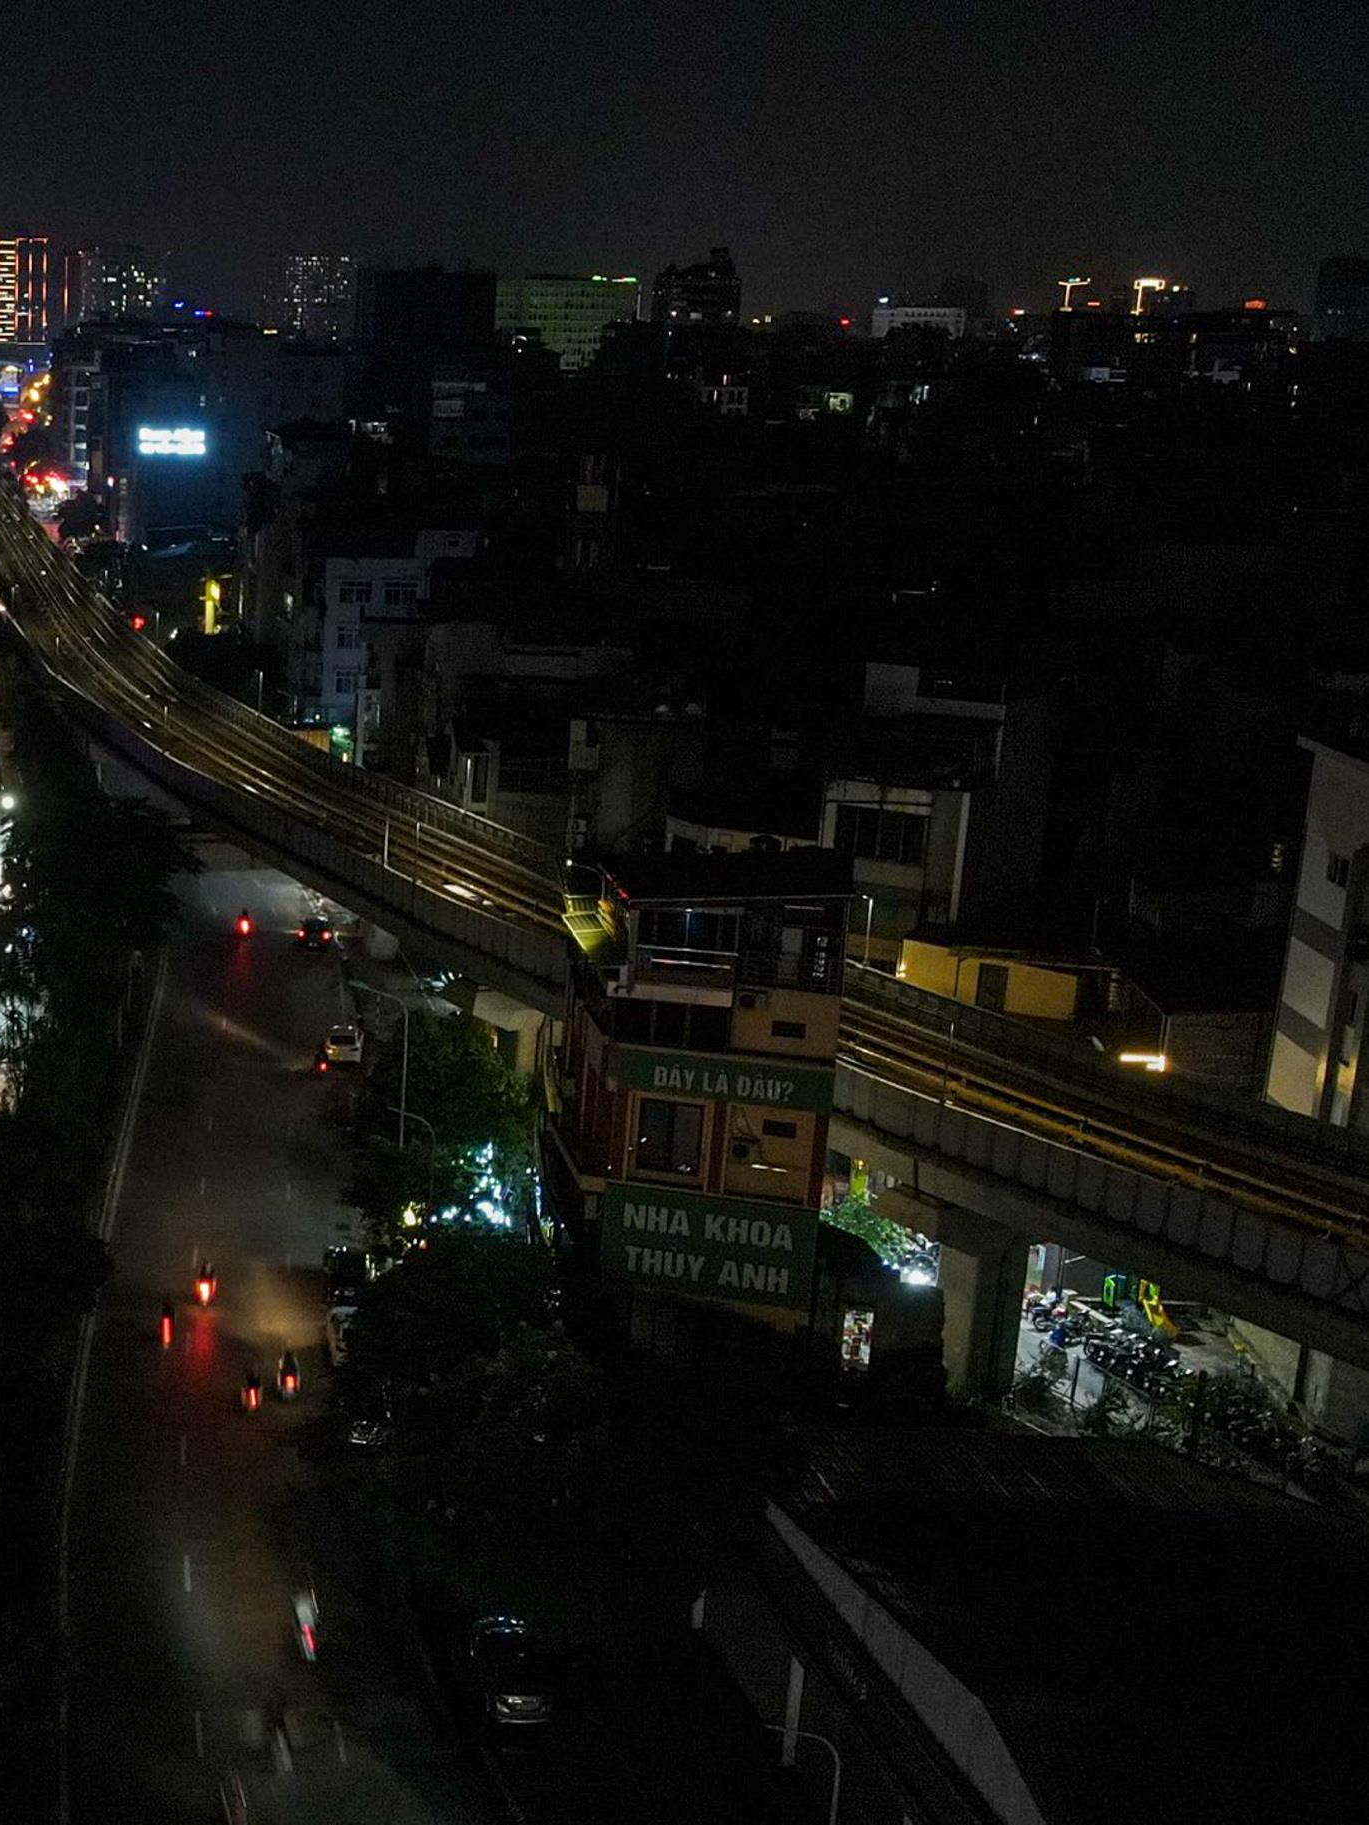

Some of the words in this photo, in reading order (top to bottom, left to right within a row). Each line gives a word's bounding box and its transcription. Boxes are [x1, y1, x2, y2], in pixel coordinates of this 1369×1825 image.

[623, 1202, 691, 1237] NHA
[703, 1213, 794, 1252] KHOA
[717, 1259, 790, 1296] ANH
